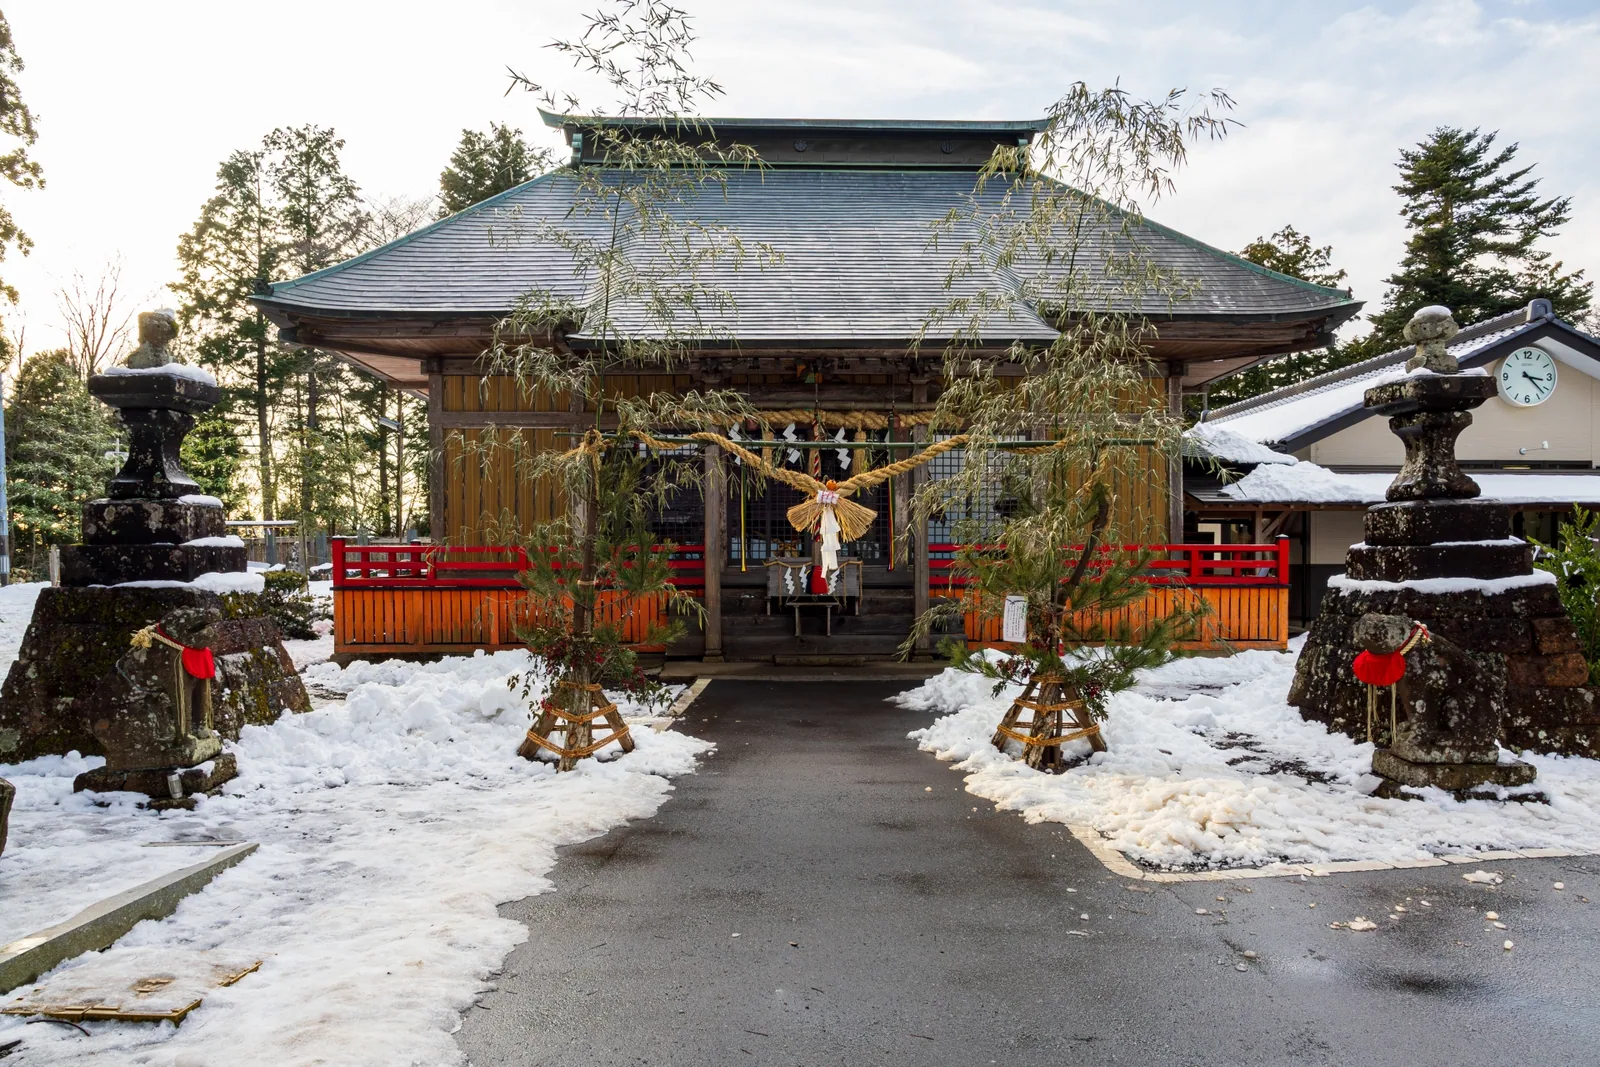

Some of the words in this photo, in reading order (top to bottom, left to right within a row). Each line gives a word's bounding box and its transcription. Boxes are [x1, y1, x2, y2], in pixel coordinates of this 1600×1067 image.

[1523, 351, 1532, 359] 12
[1503, 373, 1508, 381] 9
[1546, 373, 1552, 381] 3
[1525, 395, 1530, 403] 6
